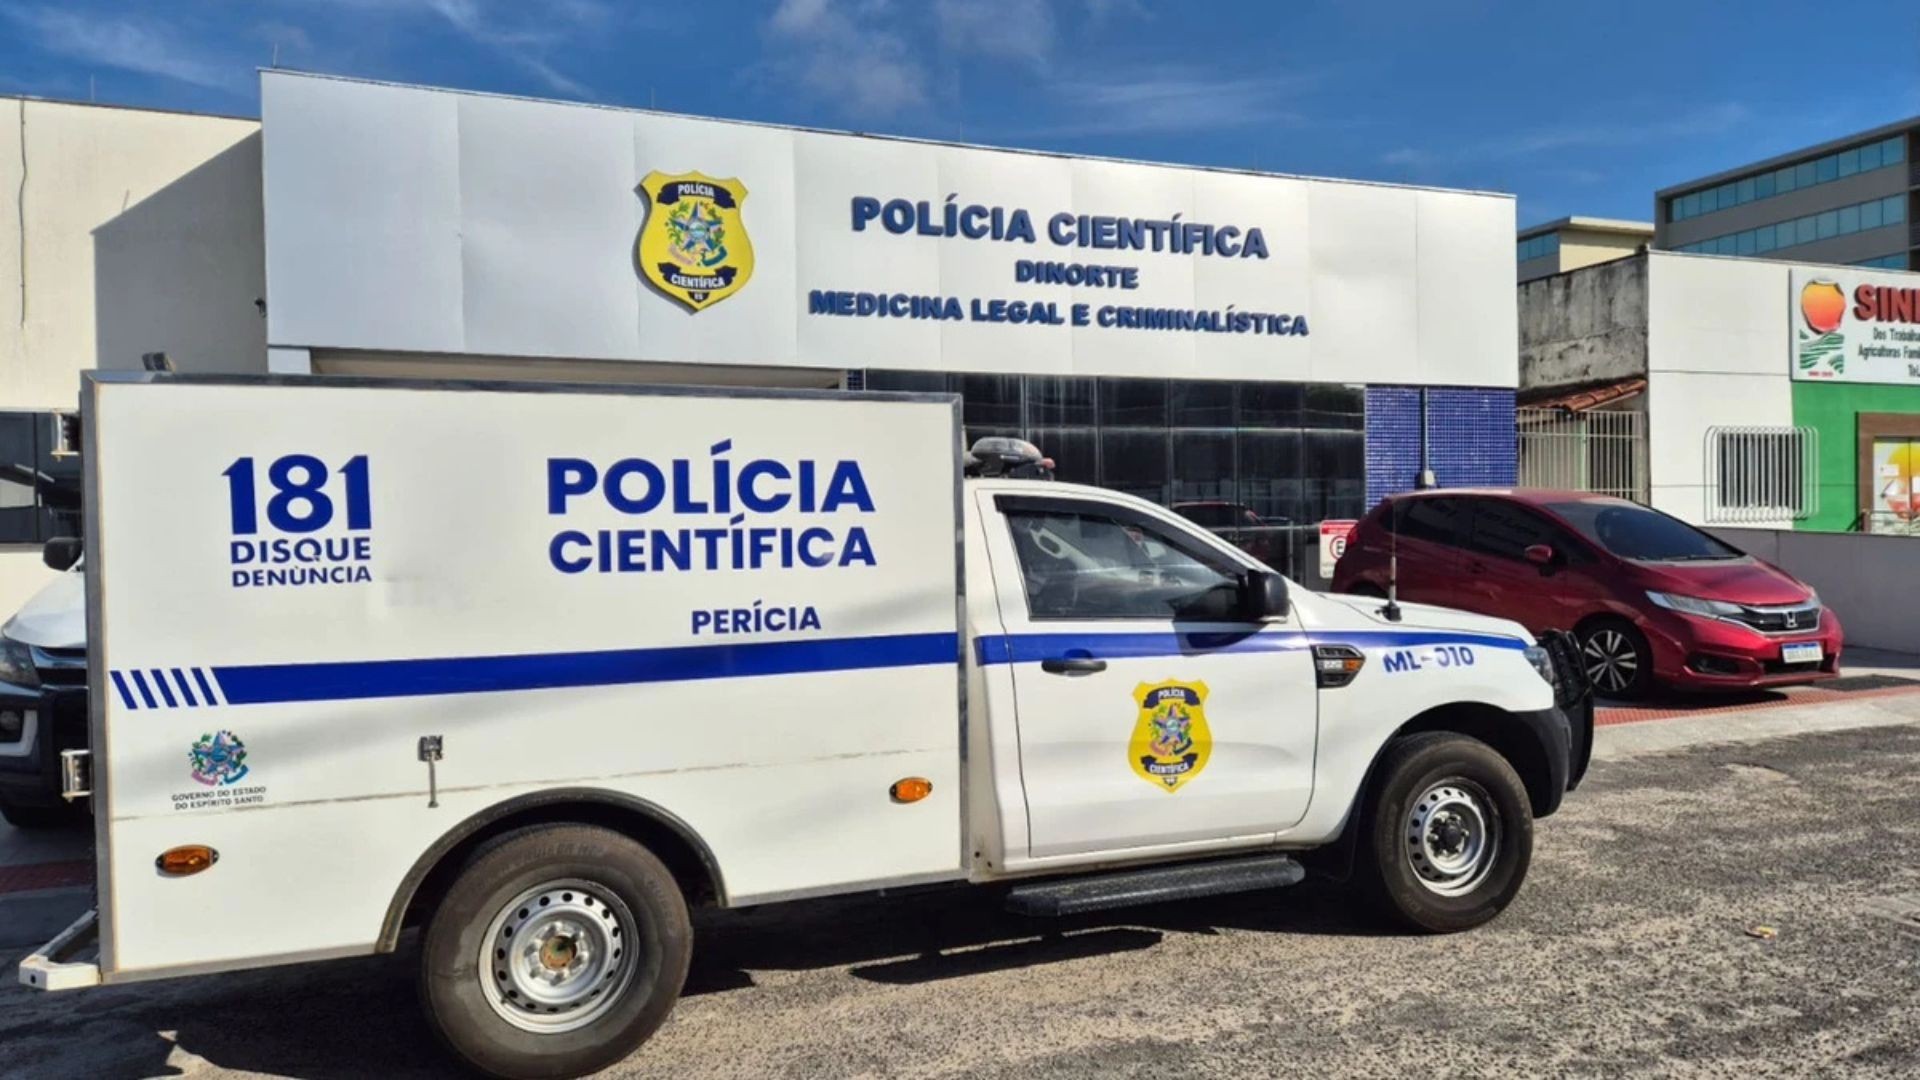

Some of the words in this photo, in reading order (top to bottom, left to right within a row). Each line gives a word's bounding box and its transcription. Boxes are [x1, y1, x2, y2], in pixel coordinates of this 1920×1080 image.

[678, 184, 714, 197] POLÍCIA
[851, 193, 1036, 243] POLÍCIA
[1048, 203, 1270, 259] CIENTÍFICA
[1015, 260, 1139, 289] DINORTE
[809, 290, 964, 321] MEDICINA
[971, 299, 1065, 326] LEGAL
[1071, 303, 1091, 327] E
[1096, 304, 1310, 337] CRIMINALÍSTICA
[221, 454, 371, 535] 181
[547, 438, 876, 514] POLÍCIA
[231, 537, 371, 564] DISQUE
[549, 512, 877, 573] CIENTÍFICA
[692, 599, 821, 634] PERÍCIA
